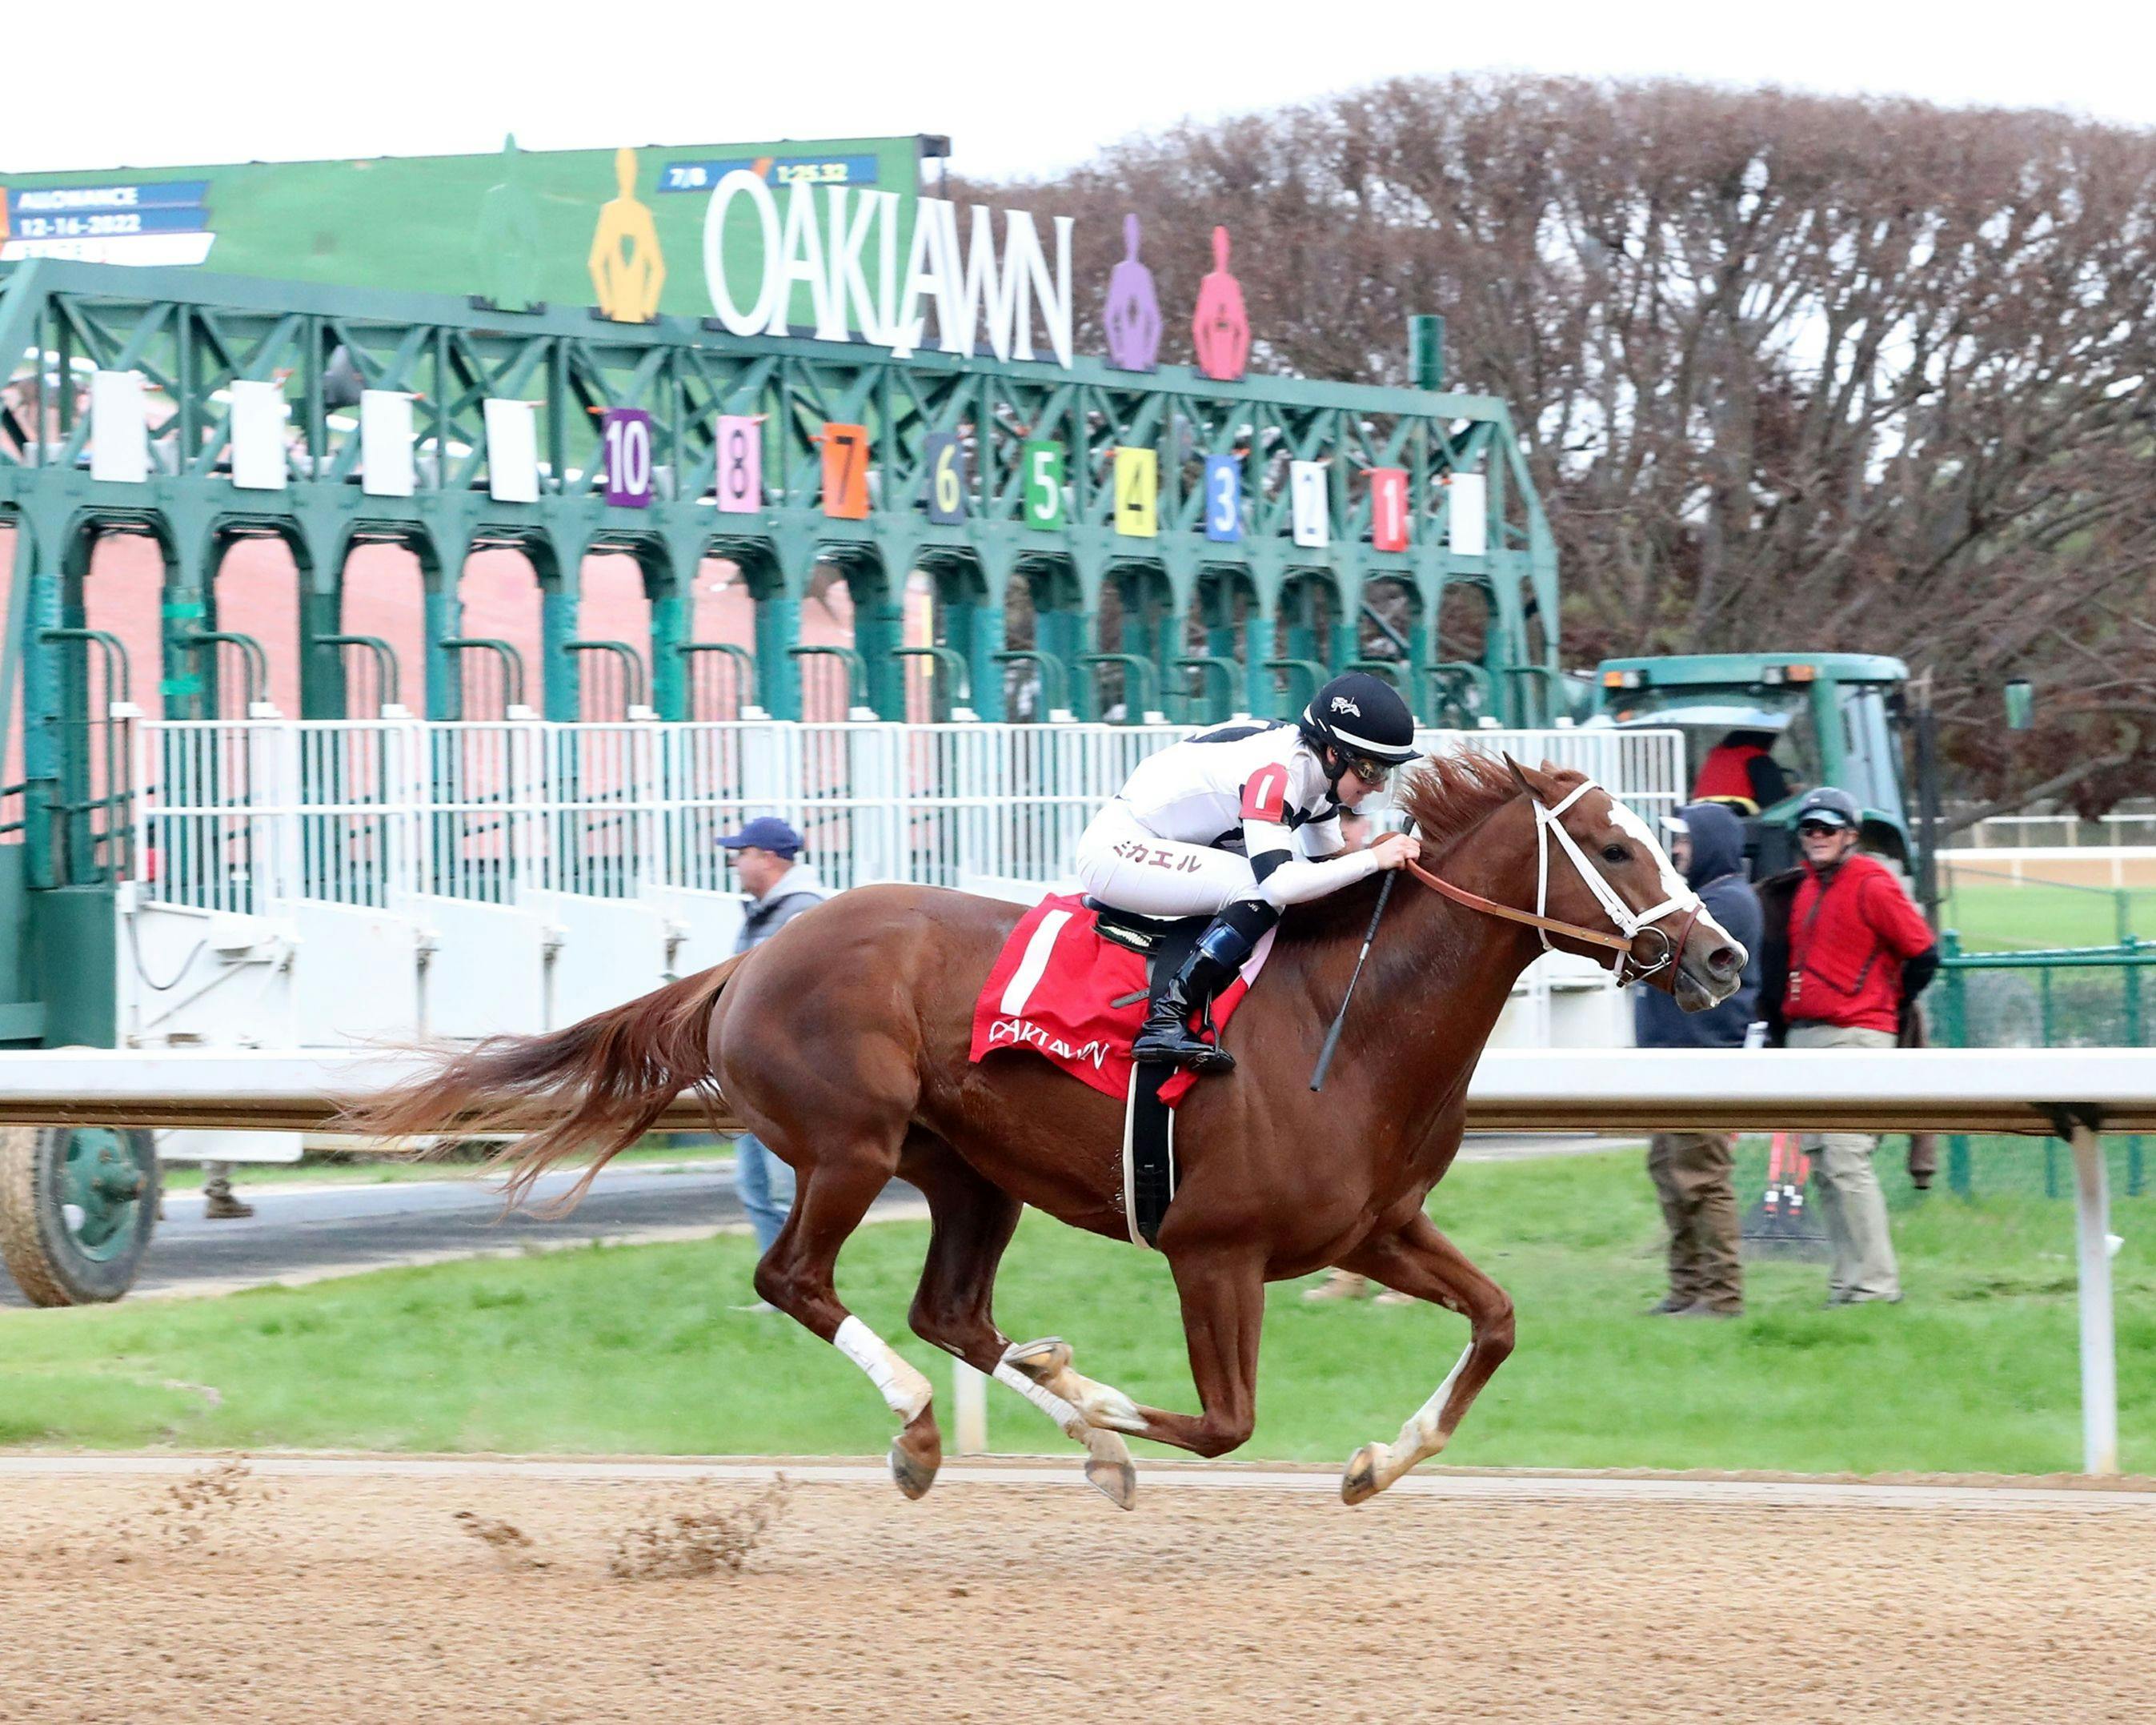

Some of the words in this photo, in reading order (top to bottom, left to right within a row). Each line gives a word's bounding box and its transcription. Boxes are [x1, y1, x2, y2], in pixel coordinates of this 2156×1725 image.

[703, 169, 1074, 370] OAKLAWN
[606, 419, 650, 495] 10
[730, 428, 747, 499] 8
[836, 436, 855, 506] 7
[936, 444, 960, 513] 6
[1033, 451, 1060, 520] 5
[1123, 460, 1144, 526] 4
[1213, 466, 1236, 532] 3
[1301, 472, 1319, 535] 2
[1384, 479, 1400, 541] 1
[1255, 773, 1275, 810] 1
[999, 909, 1074, 1017] 1
